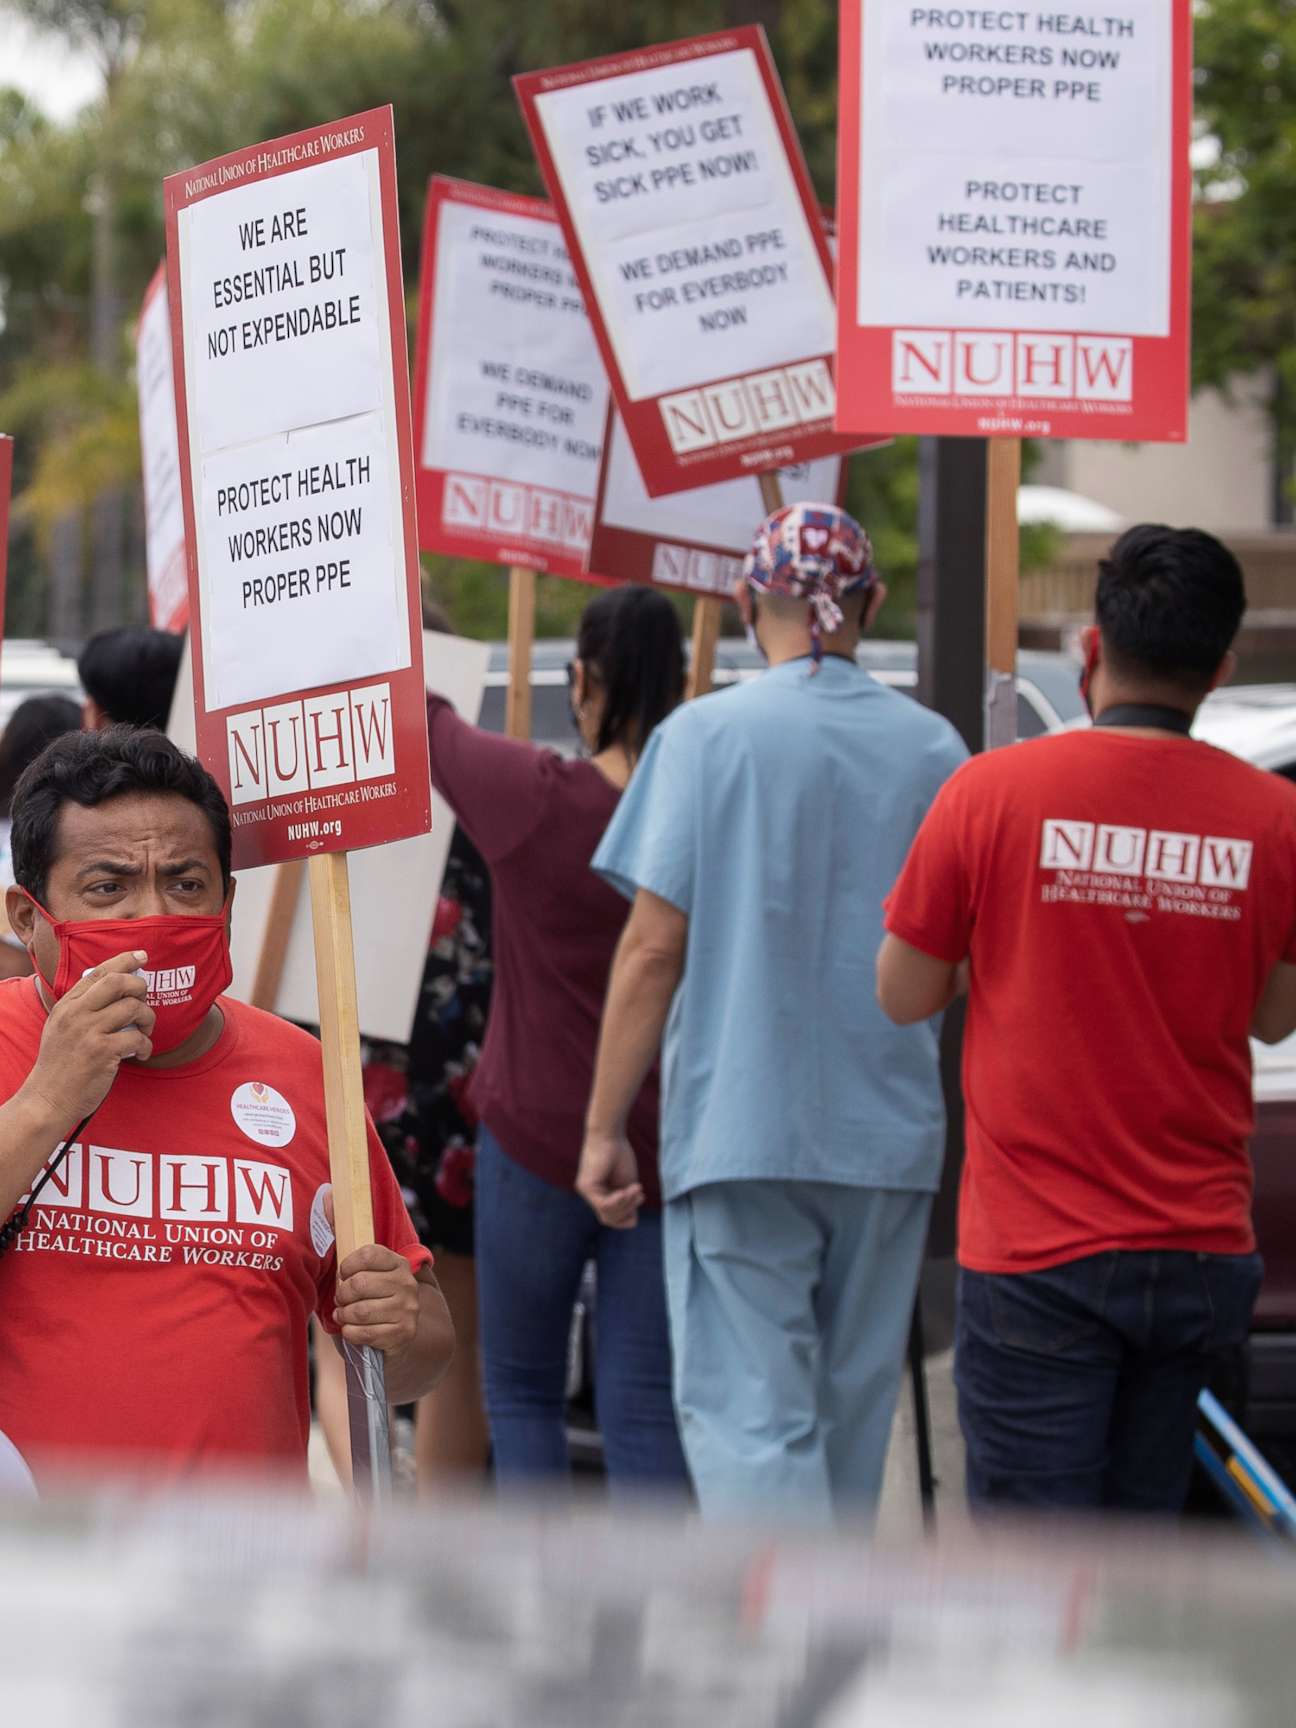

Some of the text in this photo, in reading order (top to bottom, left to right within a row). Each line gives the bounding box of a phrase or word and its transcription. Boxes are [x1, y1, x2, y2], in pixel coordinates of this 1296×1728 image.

[910, 8, 1135, 38] PROTECT HEALTH
[924, 42, 1121, 70] WORKERS NOW
[586, 81, 723, 128] IF WE WORK
[942, 75, 1102, 102] PROPER PPE
[649, 125, 696, 155] YOU
[700, 114, 744, 142] GET
[185, 173, 219, 198] NATIONAL
[218, 163, 245, 185] UNION
[258, 139, 320, 173] HEALTHCARE
[320, 126, 365, 154] WORKERS
[594, 150, 759, 203] SICK PPE NOW!
[965, 180, 1083, 205] PROTECT
[239, 208, 308, 250] WE ARE
[938, 213, 1108, 239] HEALTHCARE
[619, 228, 786, 282] WE DEMAND PPE
[926, 246, 1117, 273] WORKERS AND
[213, 249, 346, 309] ESSENTIAL BUT
[635, 287, 678, 313] FOR
[956, 279, 1087, 304] PATIENTS!
[208, 295, 361, 360] NOT EXPENDABLE
[698, 305, 748, 332] NOW
[898, 340, 1128, 389] NUHW
[668, 367, 831, 442] NUHW
[217, 472, 292, 517] PROTECT
[298, 455, 370, 497] HEALTH
[228, 507, 362, 563] WORKERS NOW
[242, 559, 352, 609] PROPER PPE
[230, 698, 389, 789] NUHW
[232, 808, 267, 828] NATIONAL
[266, 803, 293, 821] UNION
[304, 790, 360, 814] HEALTHCARE
[360, 782, 397, 801] WORKERS
[287, 819, 342, 841] NUHW.org
[1049, 824, 1249, 883] NUHW
[34, 1209, 279, 1249] NATIONAL UNION OF
[15, 1231, 284, 1272] HEALTHCARE WORKERS
